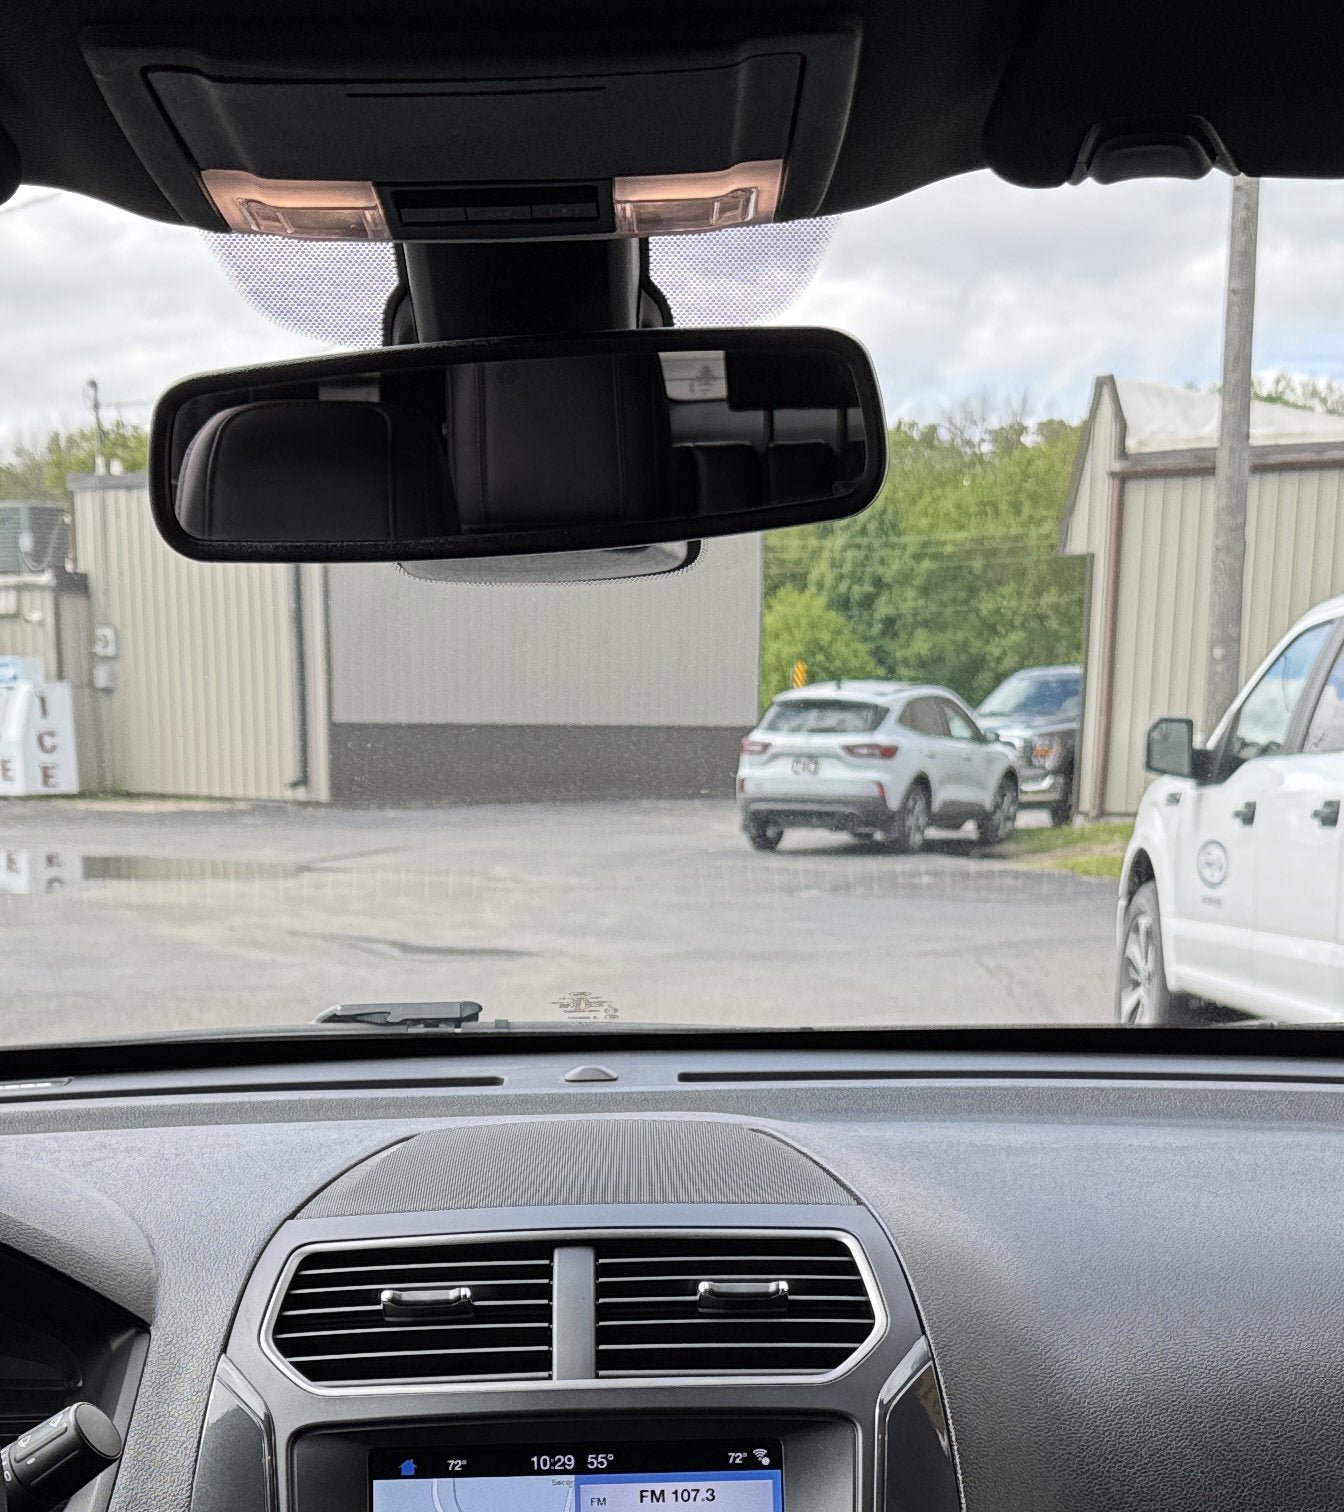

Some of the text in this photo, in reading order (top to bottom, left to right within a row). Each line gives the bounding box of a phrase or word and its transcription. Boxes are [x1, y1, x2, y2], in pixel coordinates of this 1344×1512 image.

[531, 1455, 575, 1470] 10:29
[587, 1453, 614, 1469] 55°
[590, 1497, 607, 1506] FM
[639, 1488, 716, 1504] FM 107.3
